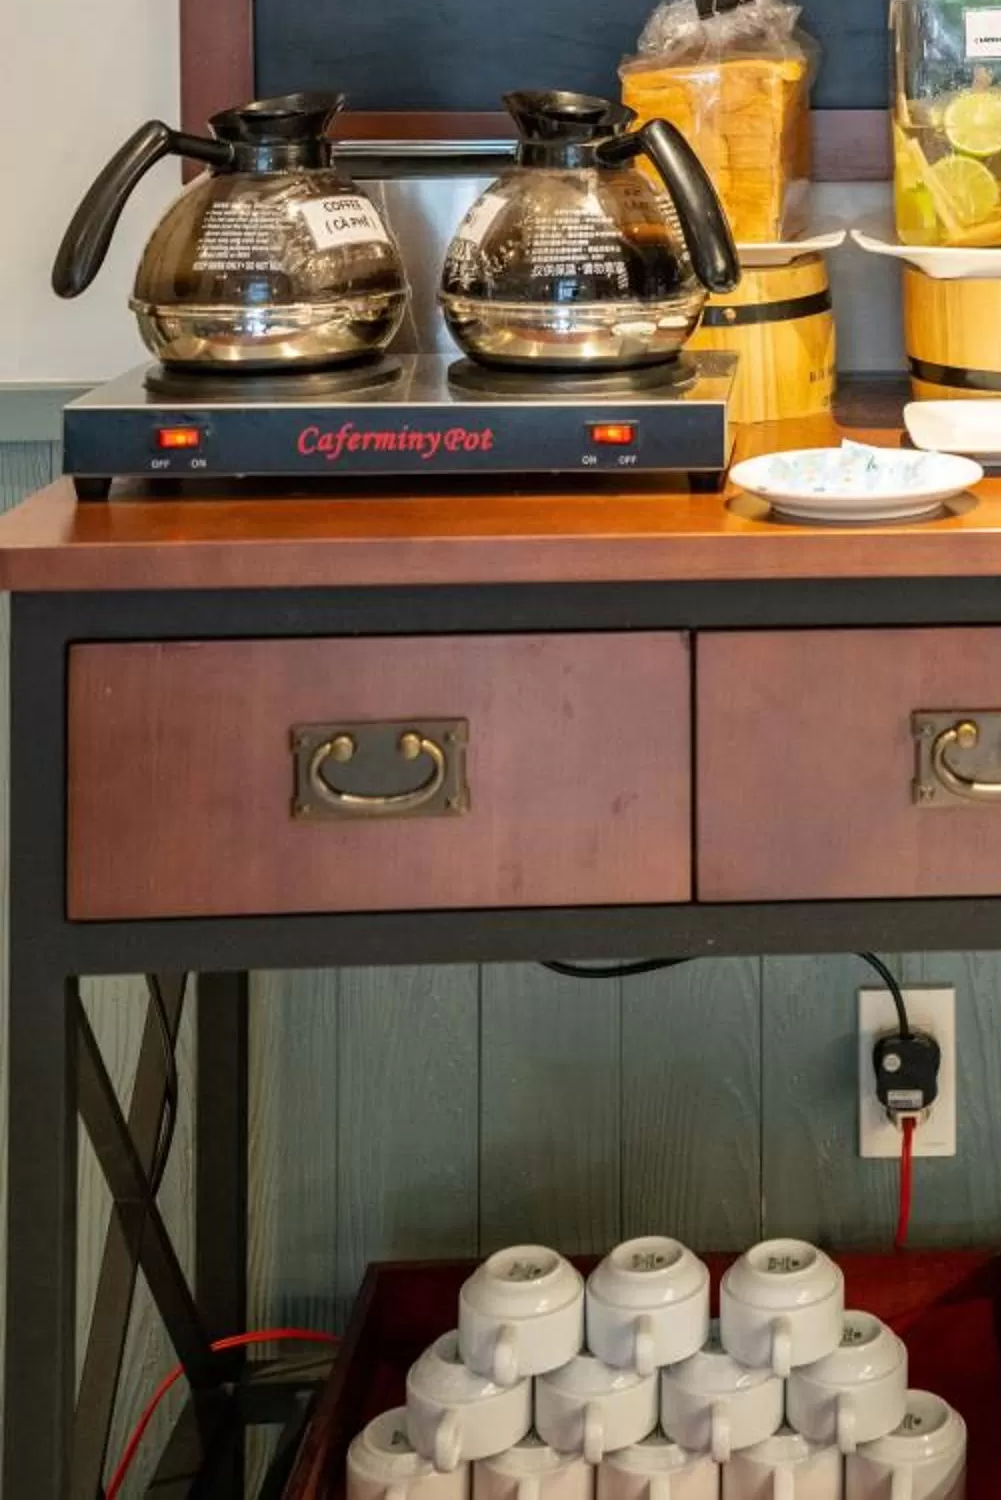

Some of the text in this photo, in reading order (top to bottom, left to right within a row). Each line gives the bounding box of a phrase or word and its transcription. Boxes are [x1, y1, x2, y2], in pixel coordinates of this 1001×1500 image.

[322, 199, 363, 213] COFFEE
[151, 459, 207, 469] OFF ON
[582, 455, 637, 465] ON OFF
